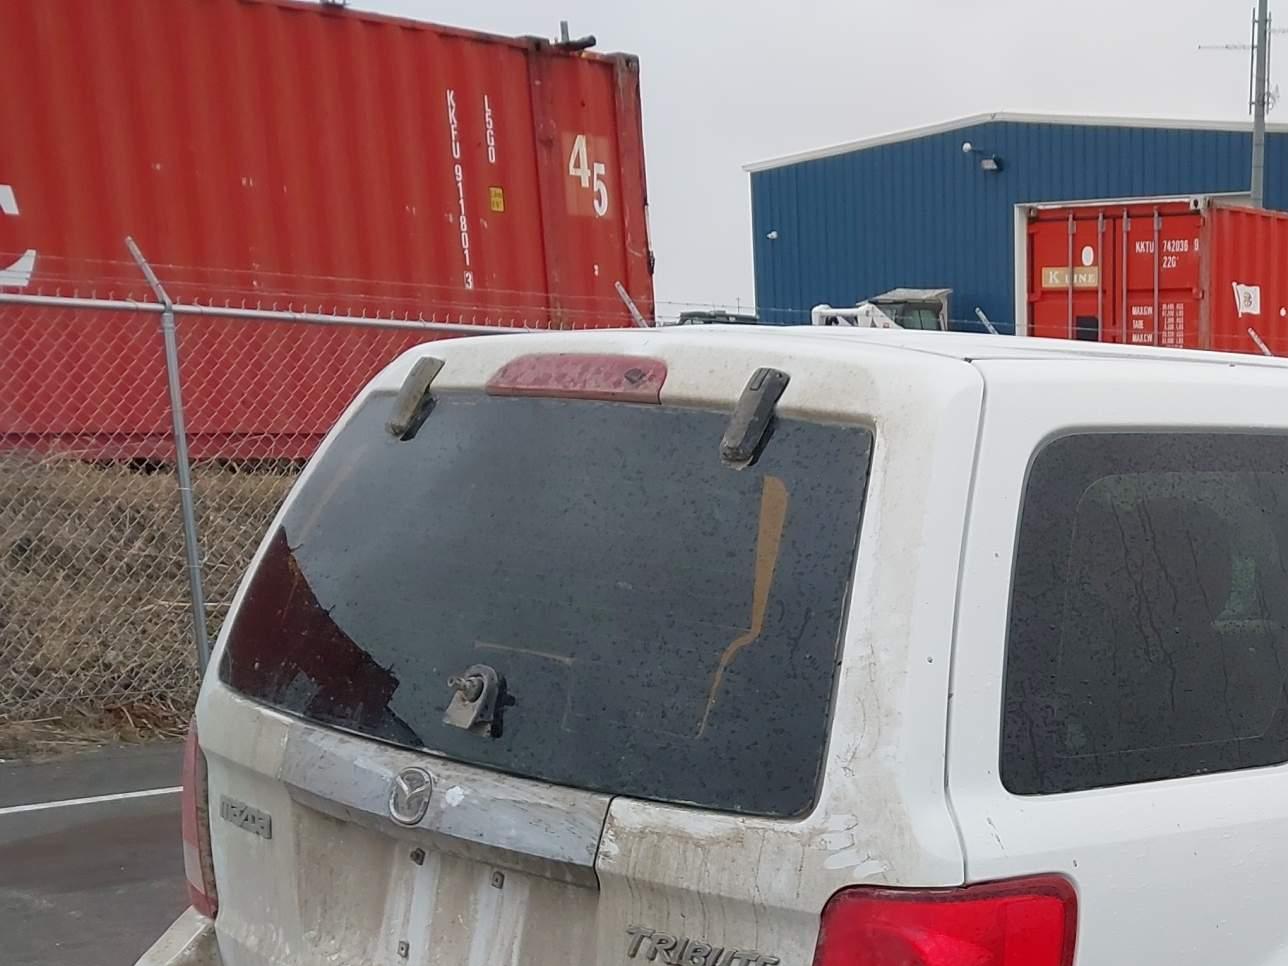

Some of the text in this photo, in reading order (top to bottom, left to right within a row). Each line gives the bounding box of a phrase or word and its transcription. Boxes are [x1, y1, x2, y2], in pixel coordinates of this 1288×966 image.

[446, 88, 461, 159] KKFU
[454, 164, 470, 266] 911801
[568, 134, 609, 217] 45
[1135, 240, 1155, 253] KKTU
[1049, 271, 1096, 284] K LINE
